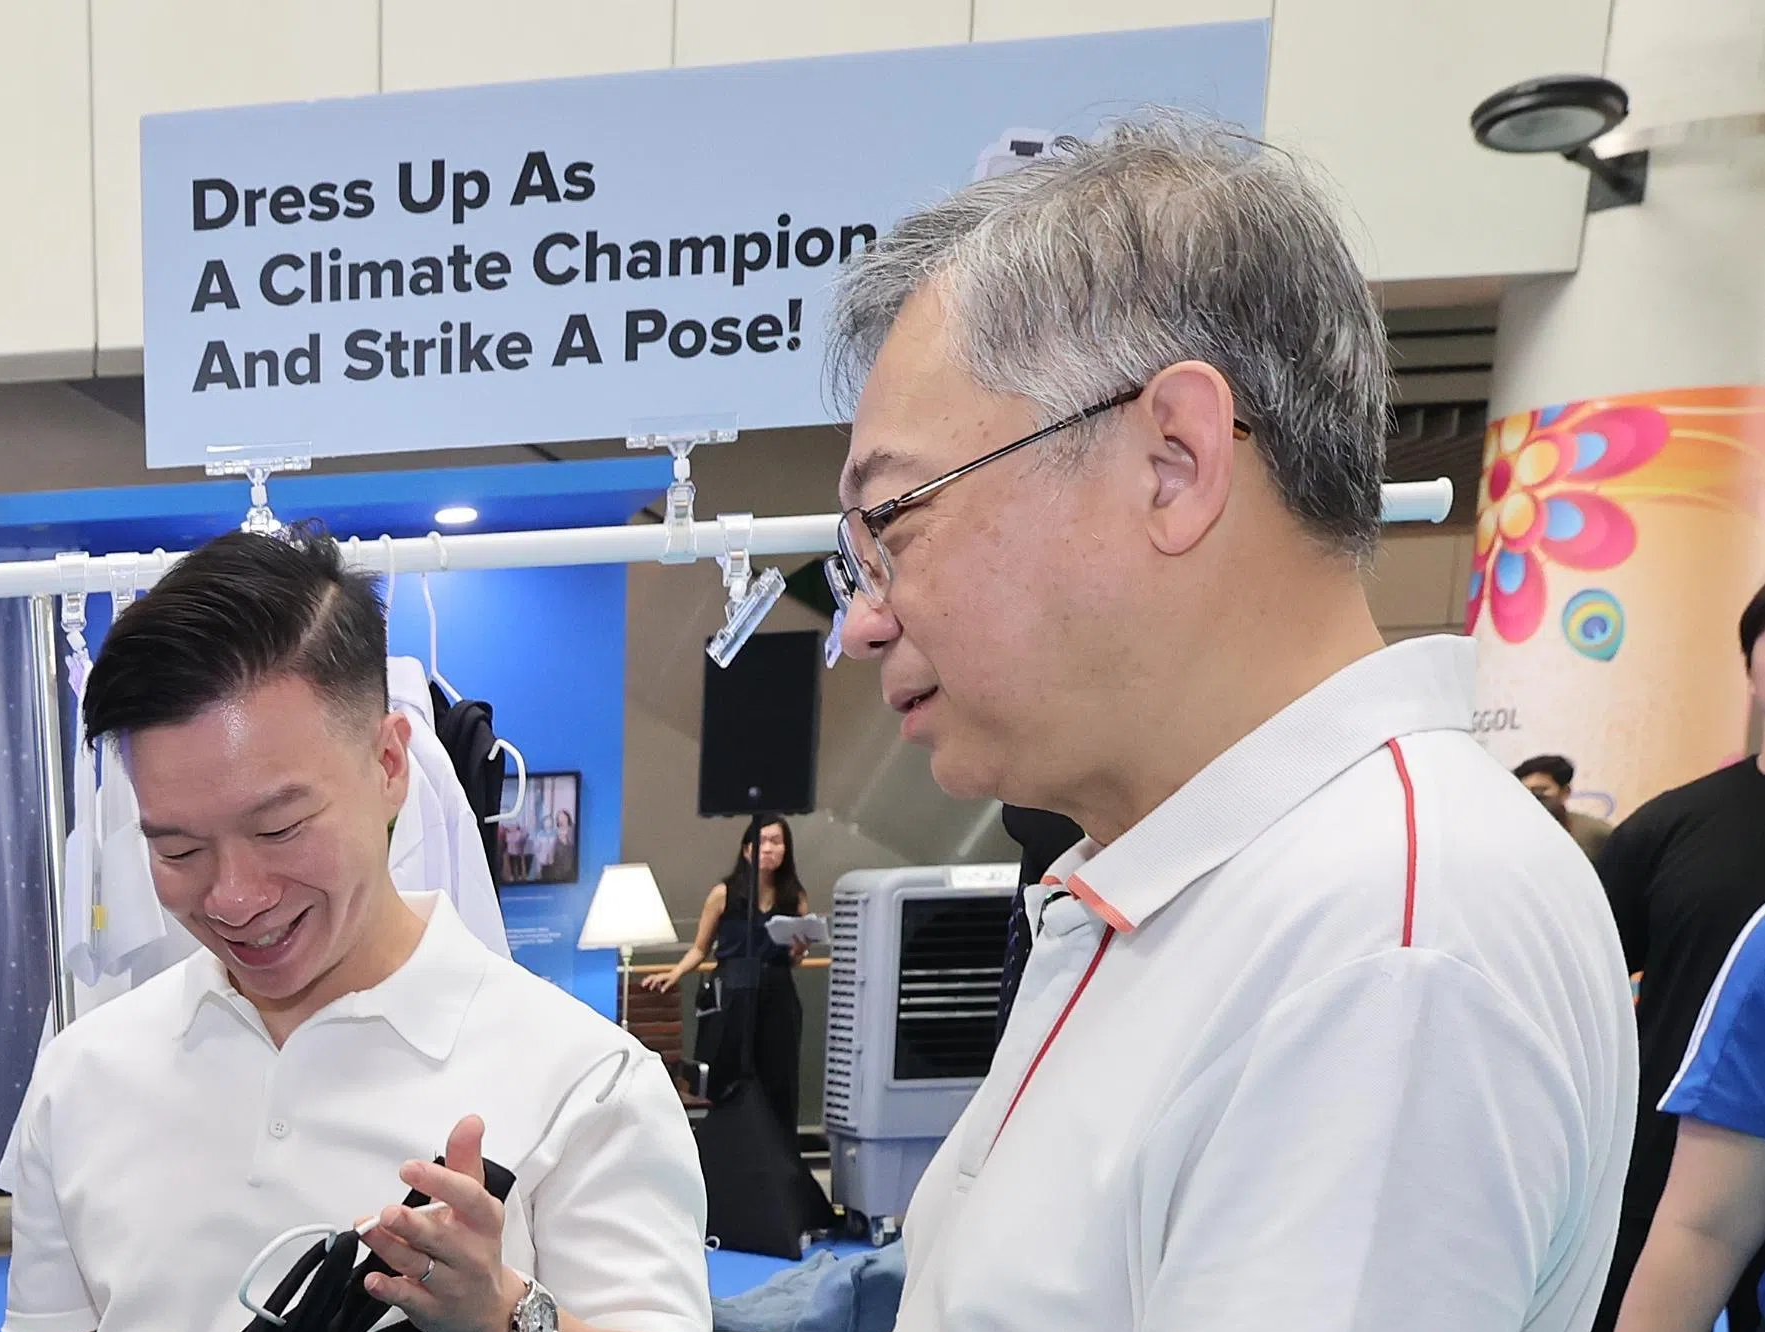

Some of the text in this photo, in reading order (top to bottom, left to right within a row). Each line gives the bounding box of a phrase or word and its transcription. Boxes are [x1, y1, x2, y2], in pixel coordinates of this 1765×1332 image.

[192, 150, 597, 232] Dress Up As
[190, 213, 879, 313] A Climate Champion
[192, 298, 804, 394] And Strike A Pose!
